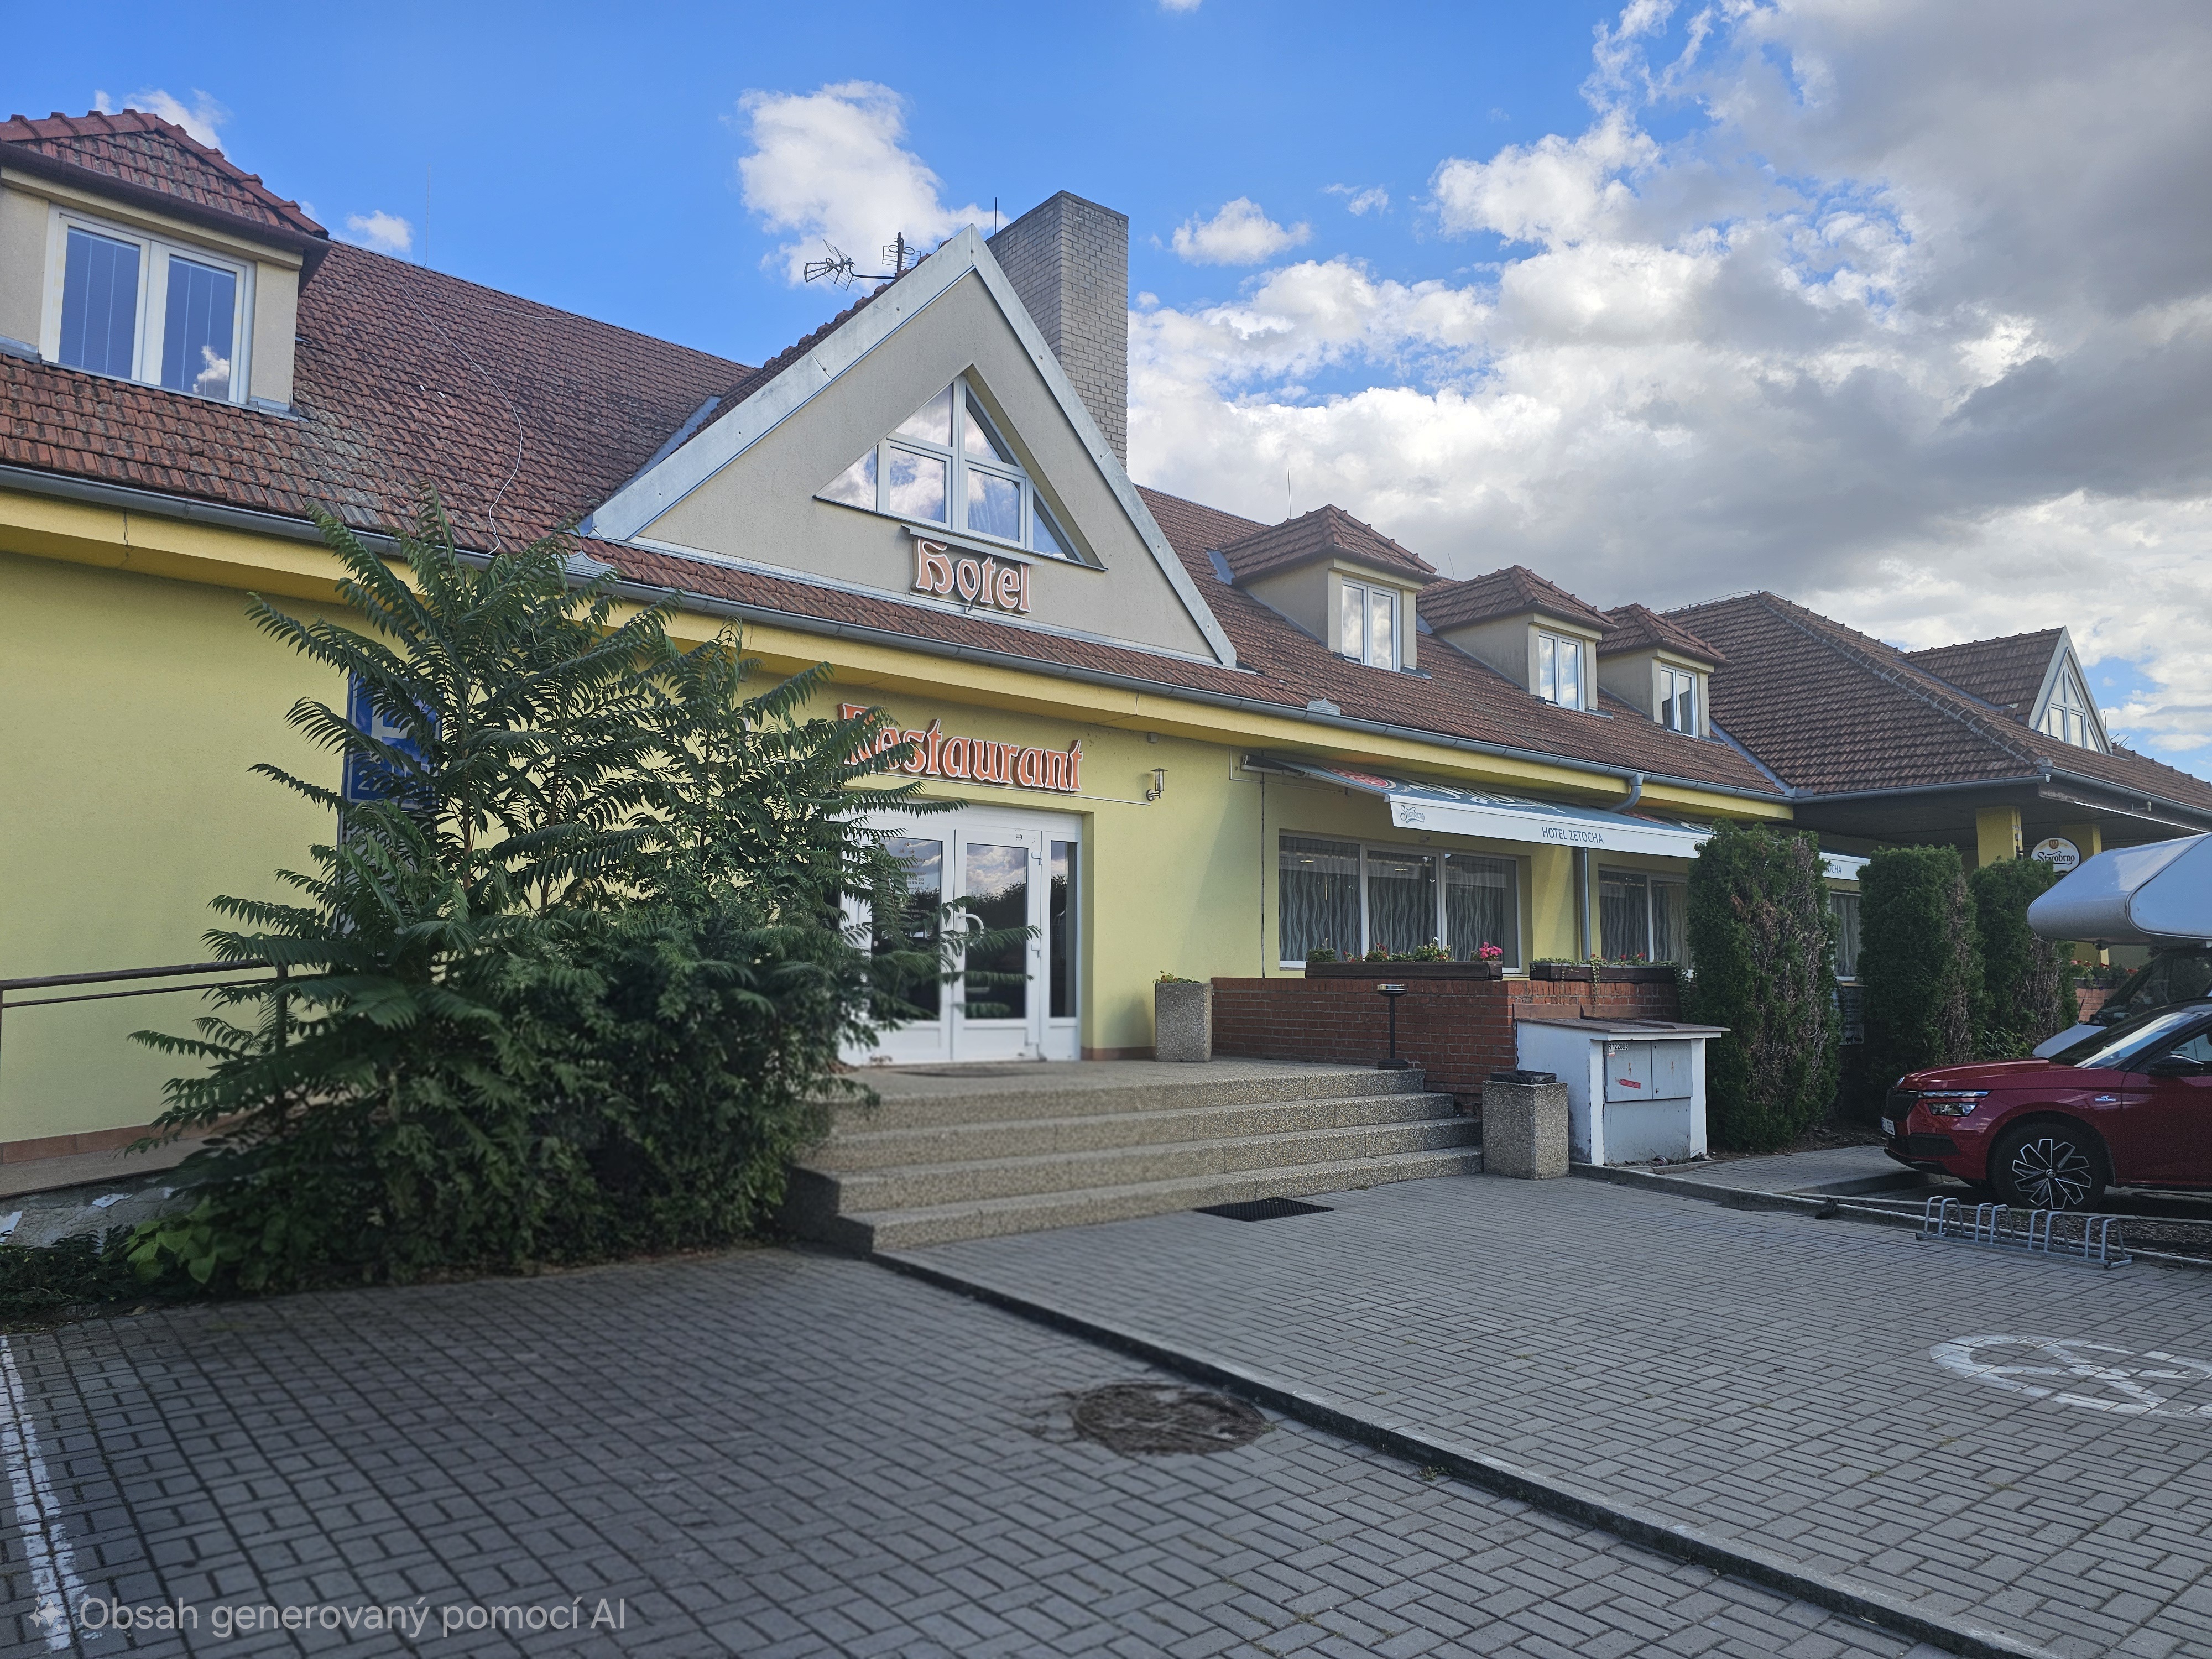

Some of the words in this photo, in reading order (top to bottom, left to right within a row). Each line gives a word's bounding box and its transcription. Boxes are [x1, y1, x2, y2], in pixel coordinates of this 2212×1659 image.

[915, 537, 1031, 613] Hotel
[1542, 827, 1568, 840] HOTEL
[1568, 830, 1604, 844] ZETOCHA
[2036, 851, 2075, 865] Starobrno
